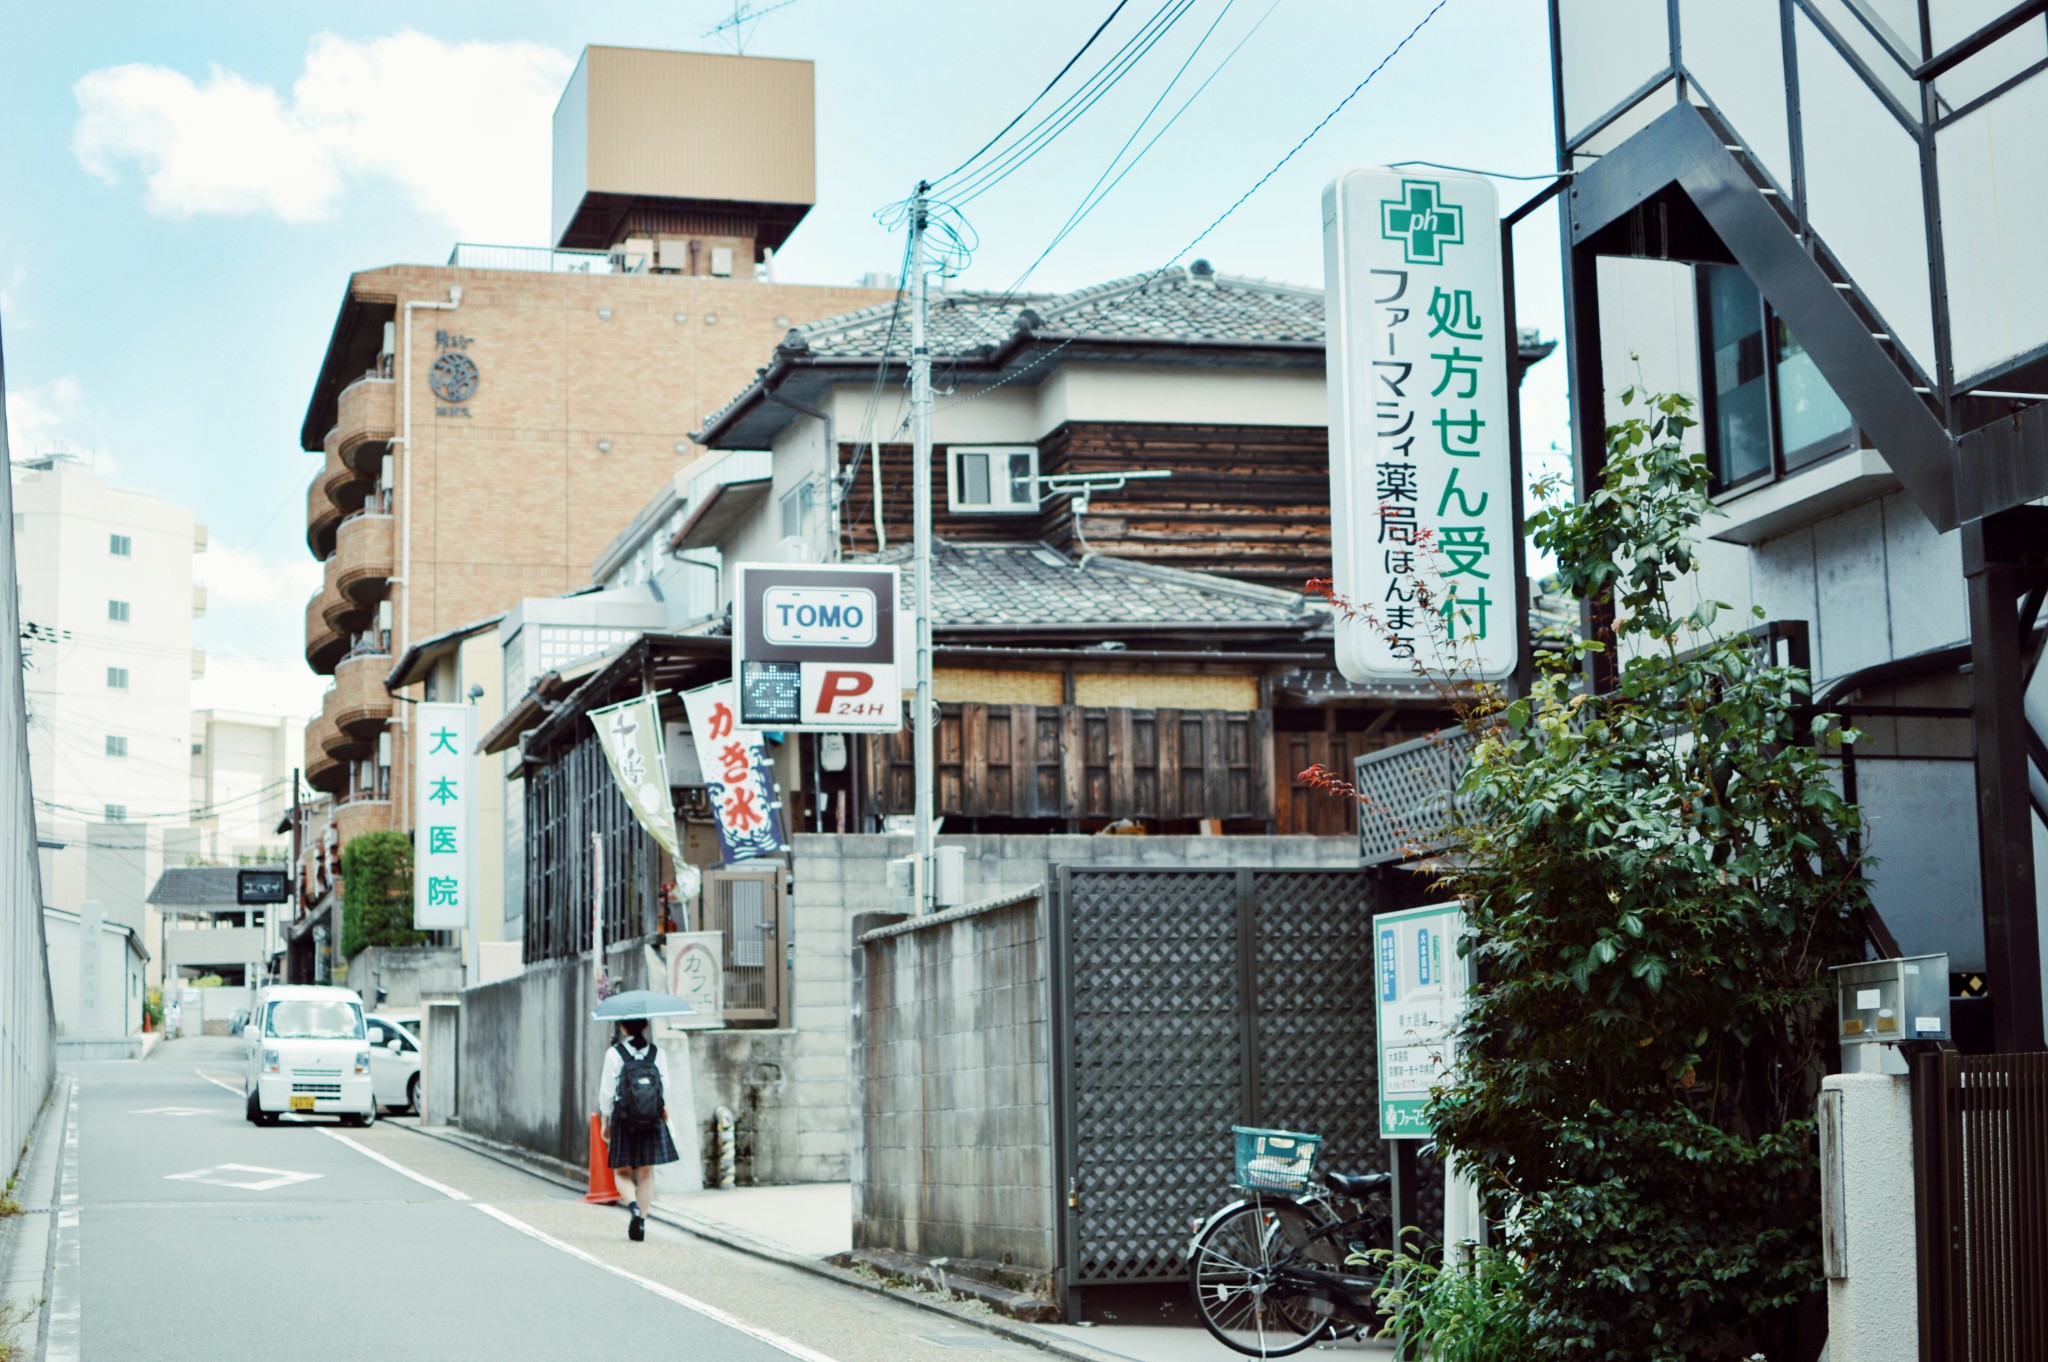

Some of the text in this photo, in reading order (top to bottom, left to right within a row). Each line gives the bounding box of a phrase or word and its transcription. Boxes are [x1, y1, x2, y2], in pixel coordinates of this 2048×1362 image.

[1408, 207, 1439, 233] ph
[1426, 285, 1492, 641] 処方せん受付
[776, 604, 863, 628] TOMO
[745, 665, 800, 718] 空
[815, 671, 874, 714] P
[838, 703, 884, 715] 24H
[708, 702, 763, 831] かき氷
[428, 726, 458, 906] 大本医院
[683, 954, 713, 1005] カフェ
